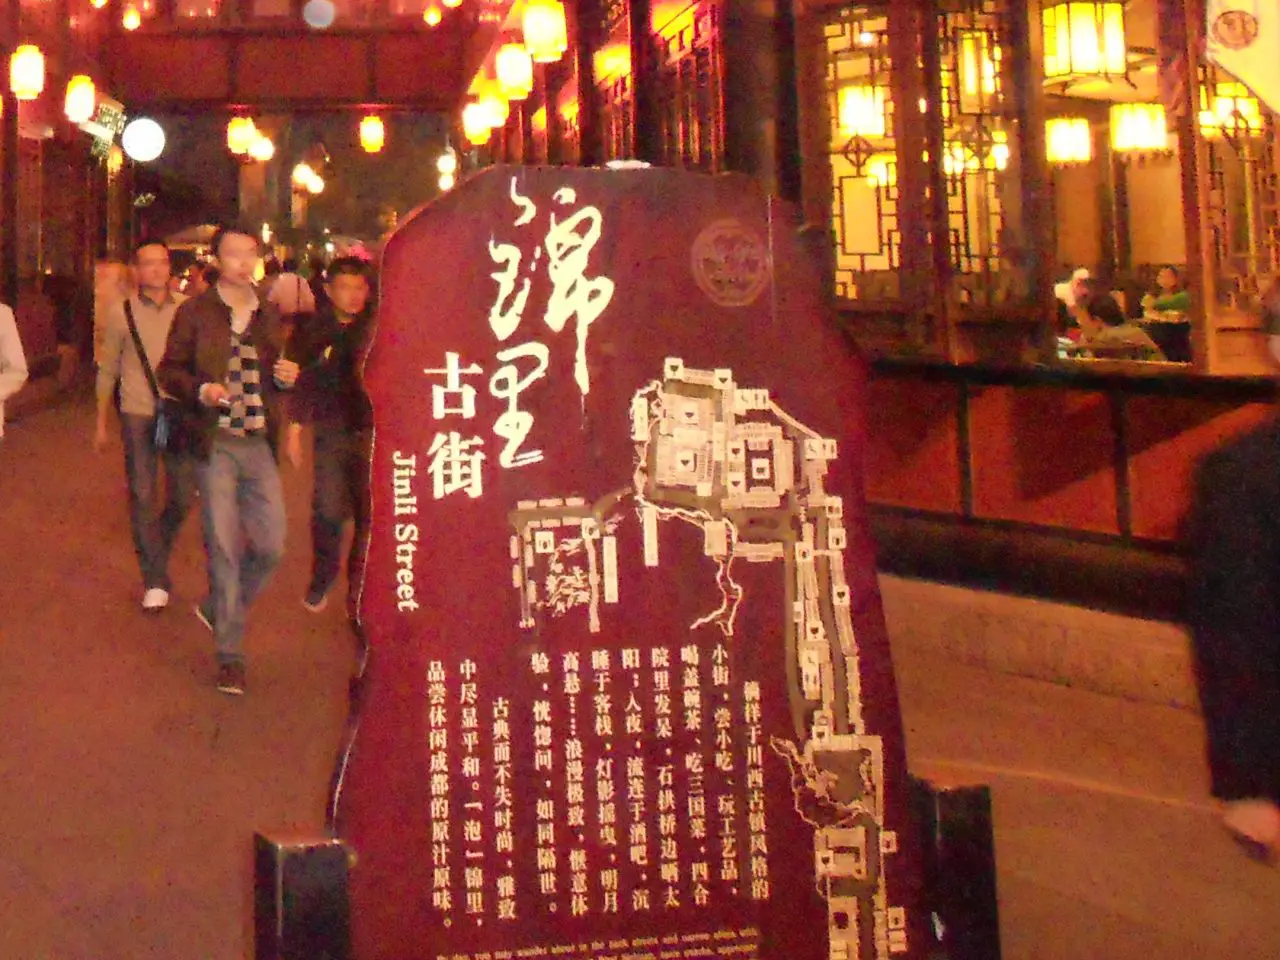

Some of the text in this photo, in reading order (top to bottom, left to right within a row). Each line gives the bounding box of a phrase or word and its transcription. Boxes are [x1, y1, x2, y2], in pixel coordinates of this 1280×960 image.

[423, 351, 486, 499] 古街
[392, 450, 420, 613] Jinli Street
